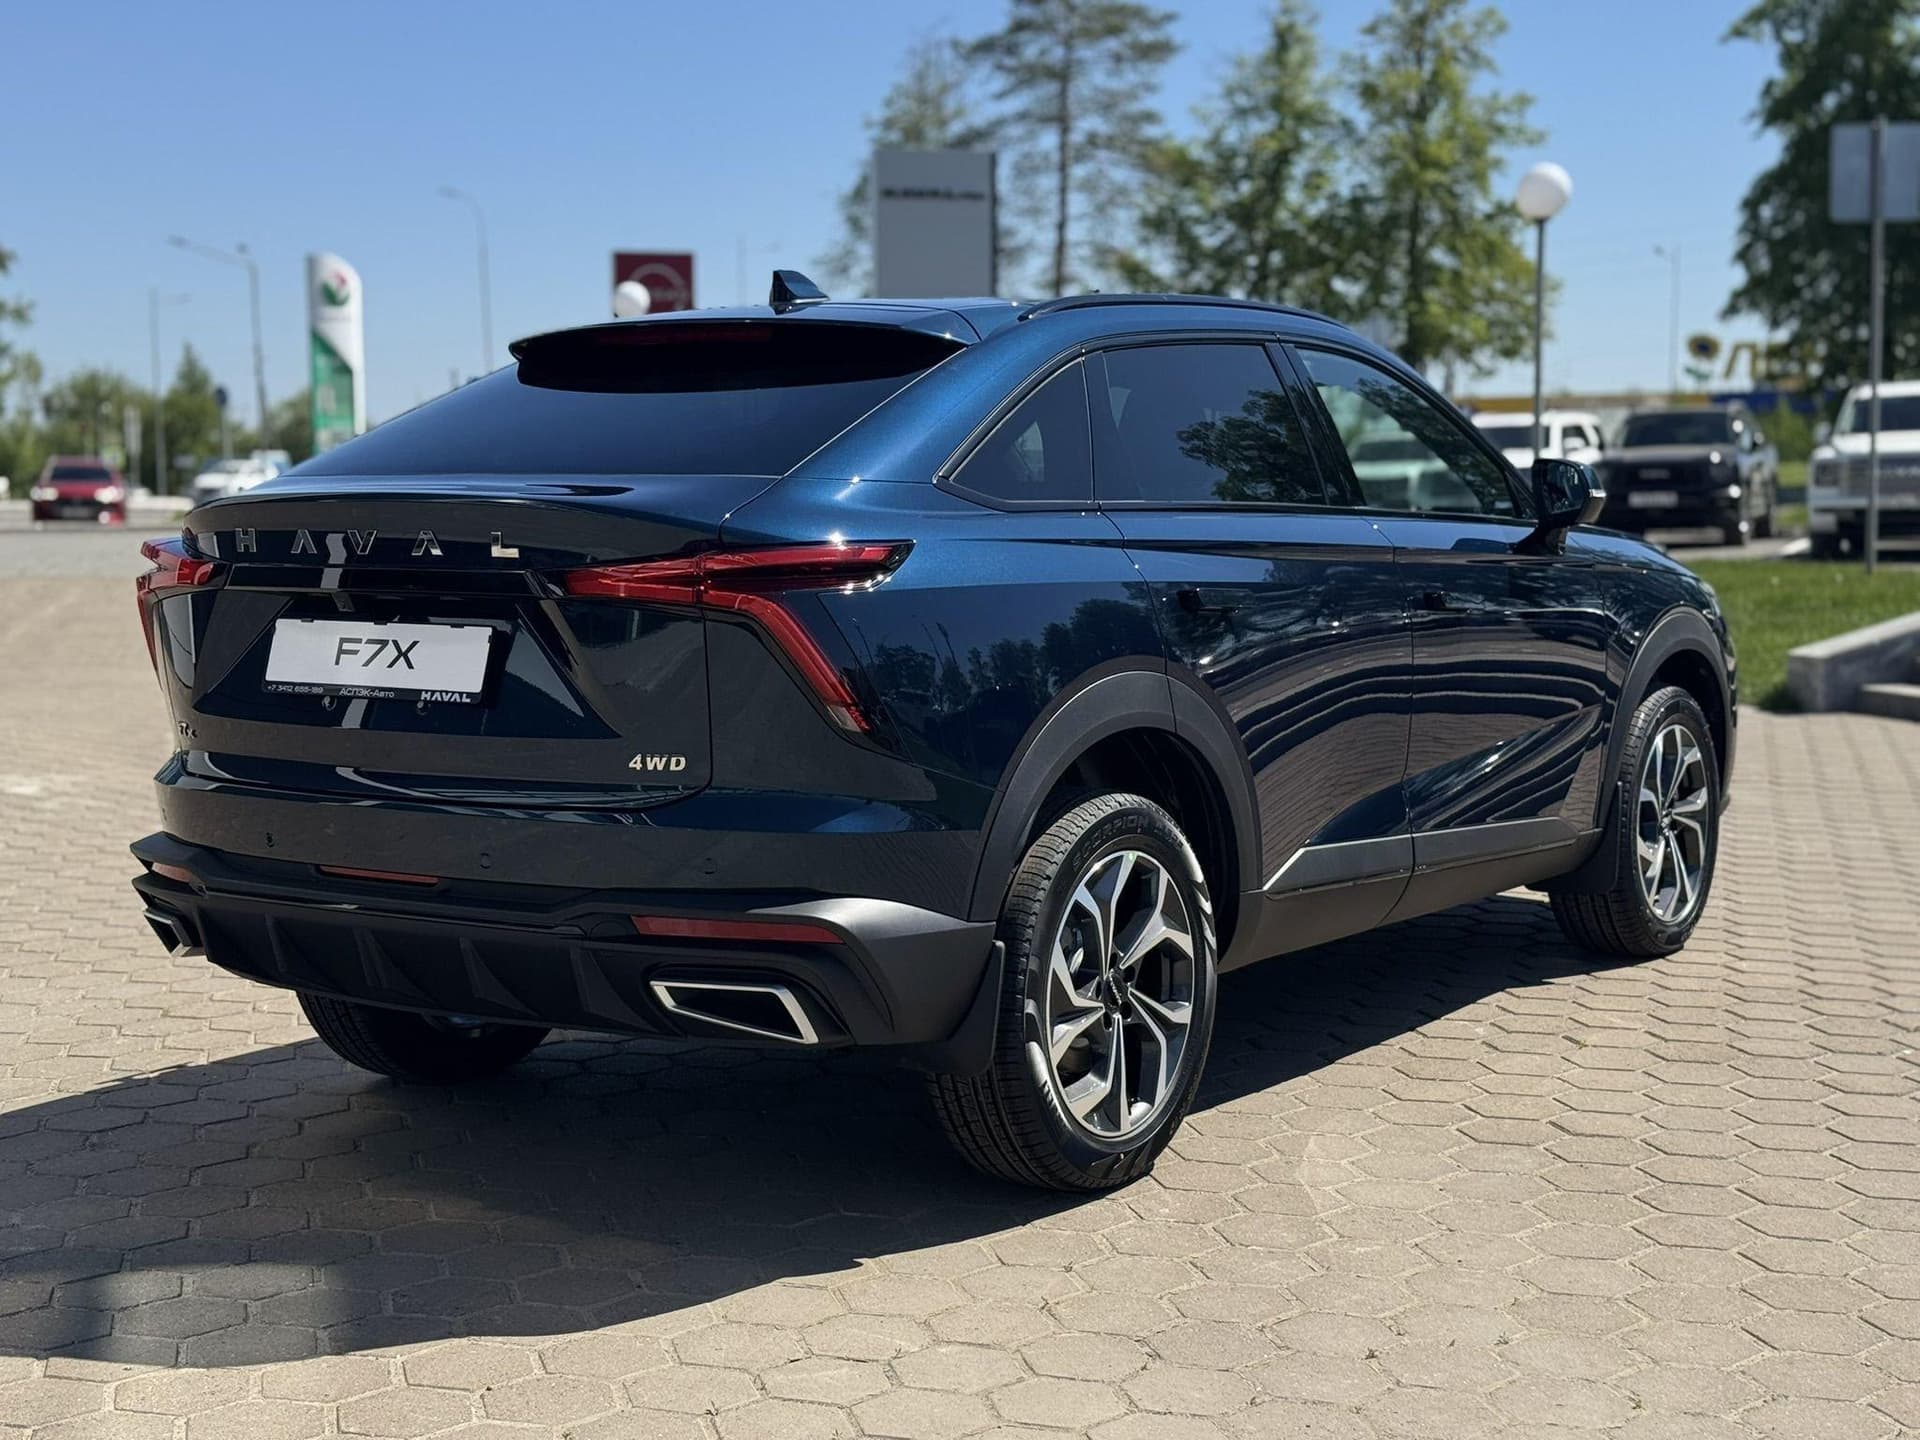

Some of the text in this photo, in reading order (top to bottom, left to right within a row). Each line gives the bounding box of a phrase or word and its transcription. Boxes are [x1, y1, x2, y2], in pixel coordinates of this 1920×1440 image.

[234, 527, 520, 558] HAVAL
[334, 637, 421, 670] F7X
[339, 687, 395, 698] АСПЭК-Авто
[420, 690, 472, 703] HAVAL
[628, 753, 687, 771] 4WD
